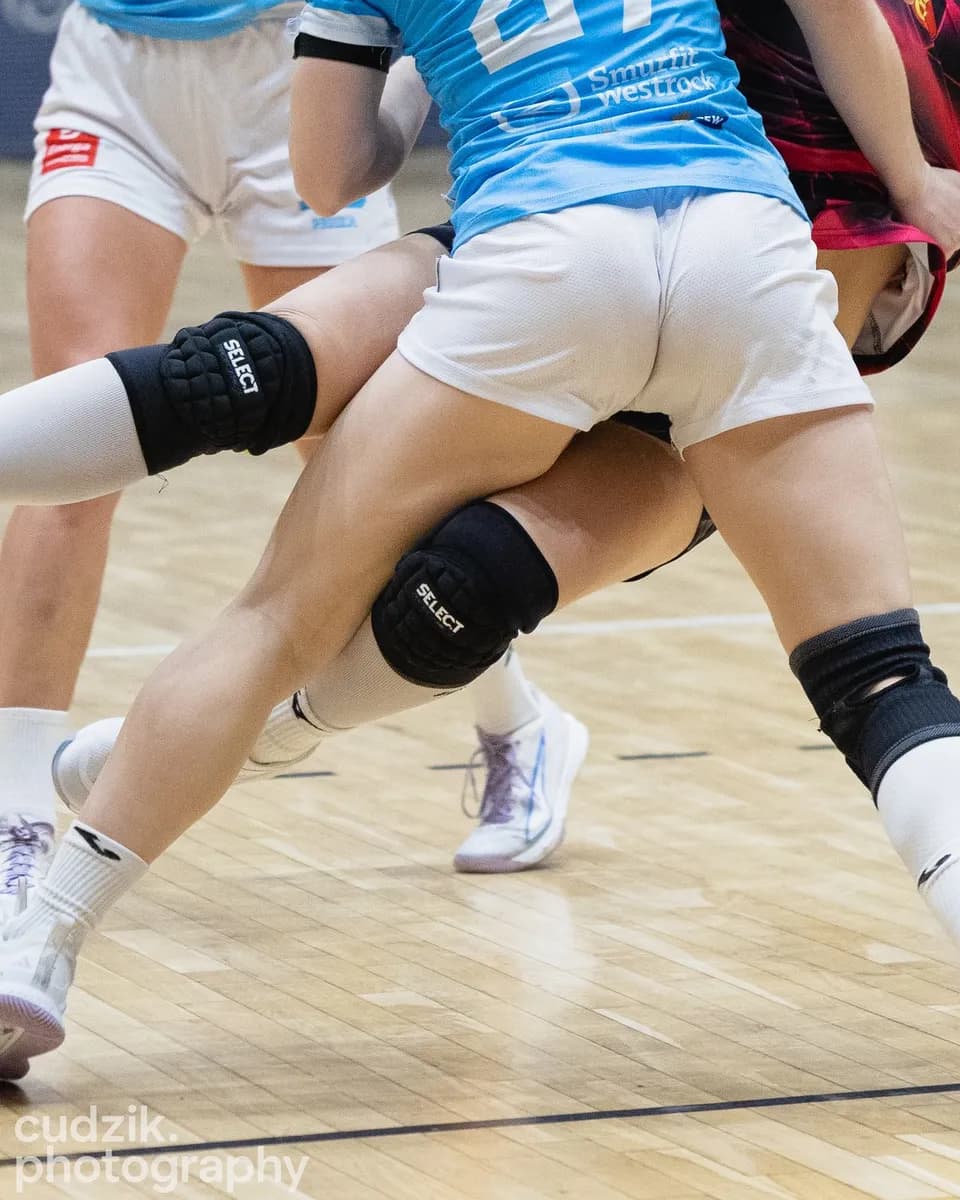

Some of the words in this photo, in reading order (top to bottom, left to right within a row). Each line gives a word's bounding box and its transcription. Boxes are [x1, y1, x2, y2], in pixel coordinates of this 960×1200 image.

[587, 45, 699, 92] Smurfit
[596, 70, 716, 107] westrock
[223, 338, 259, 394] SELECT
[416, 583, 465, 634] SELECT
